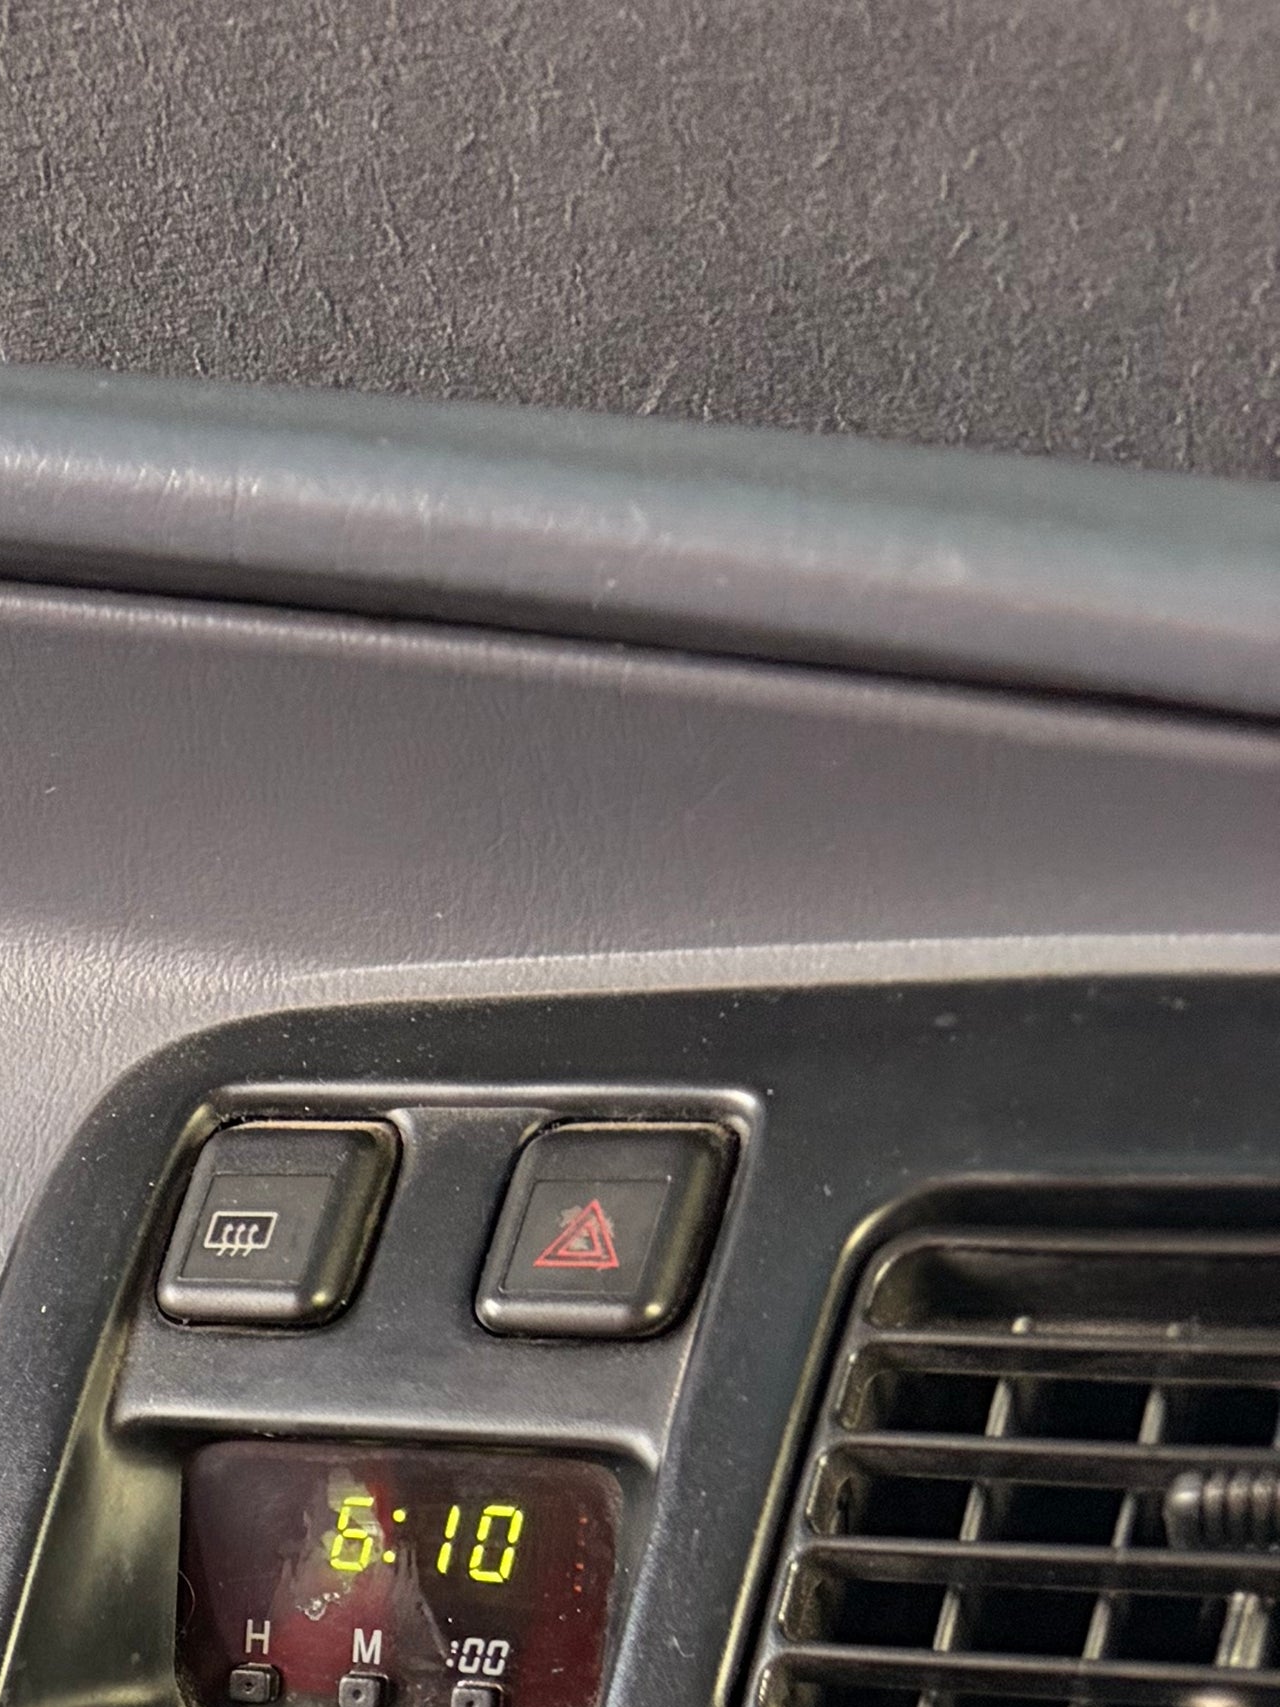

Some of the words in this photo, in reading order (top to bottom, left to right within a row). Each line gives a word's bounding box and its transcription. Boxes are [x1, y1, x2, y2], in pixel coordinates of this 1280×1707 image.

[329, 1496, 524, 1584] 6:10
[245, 1619, 272, 1655] H
[352, 1628, 382, 1664] M
